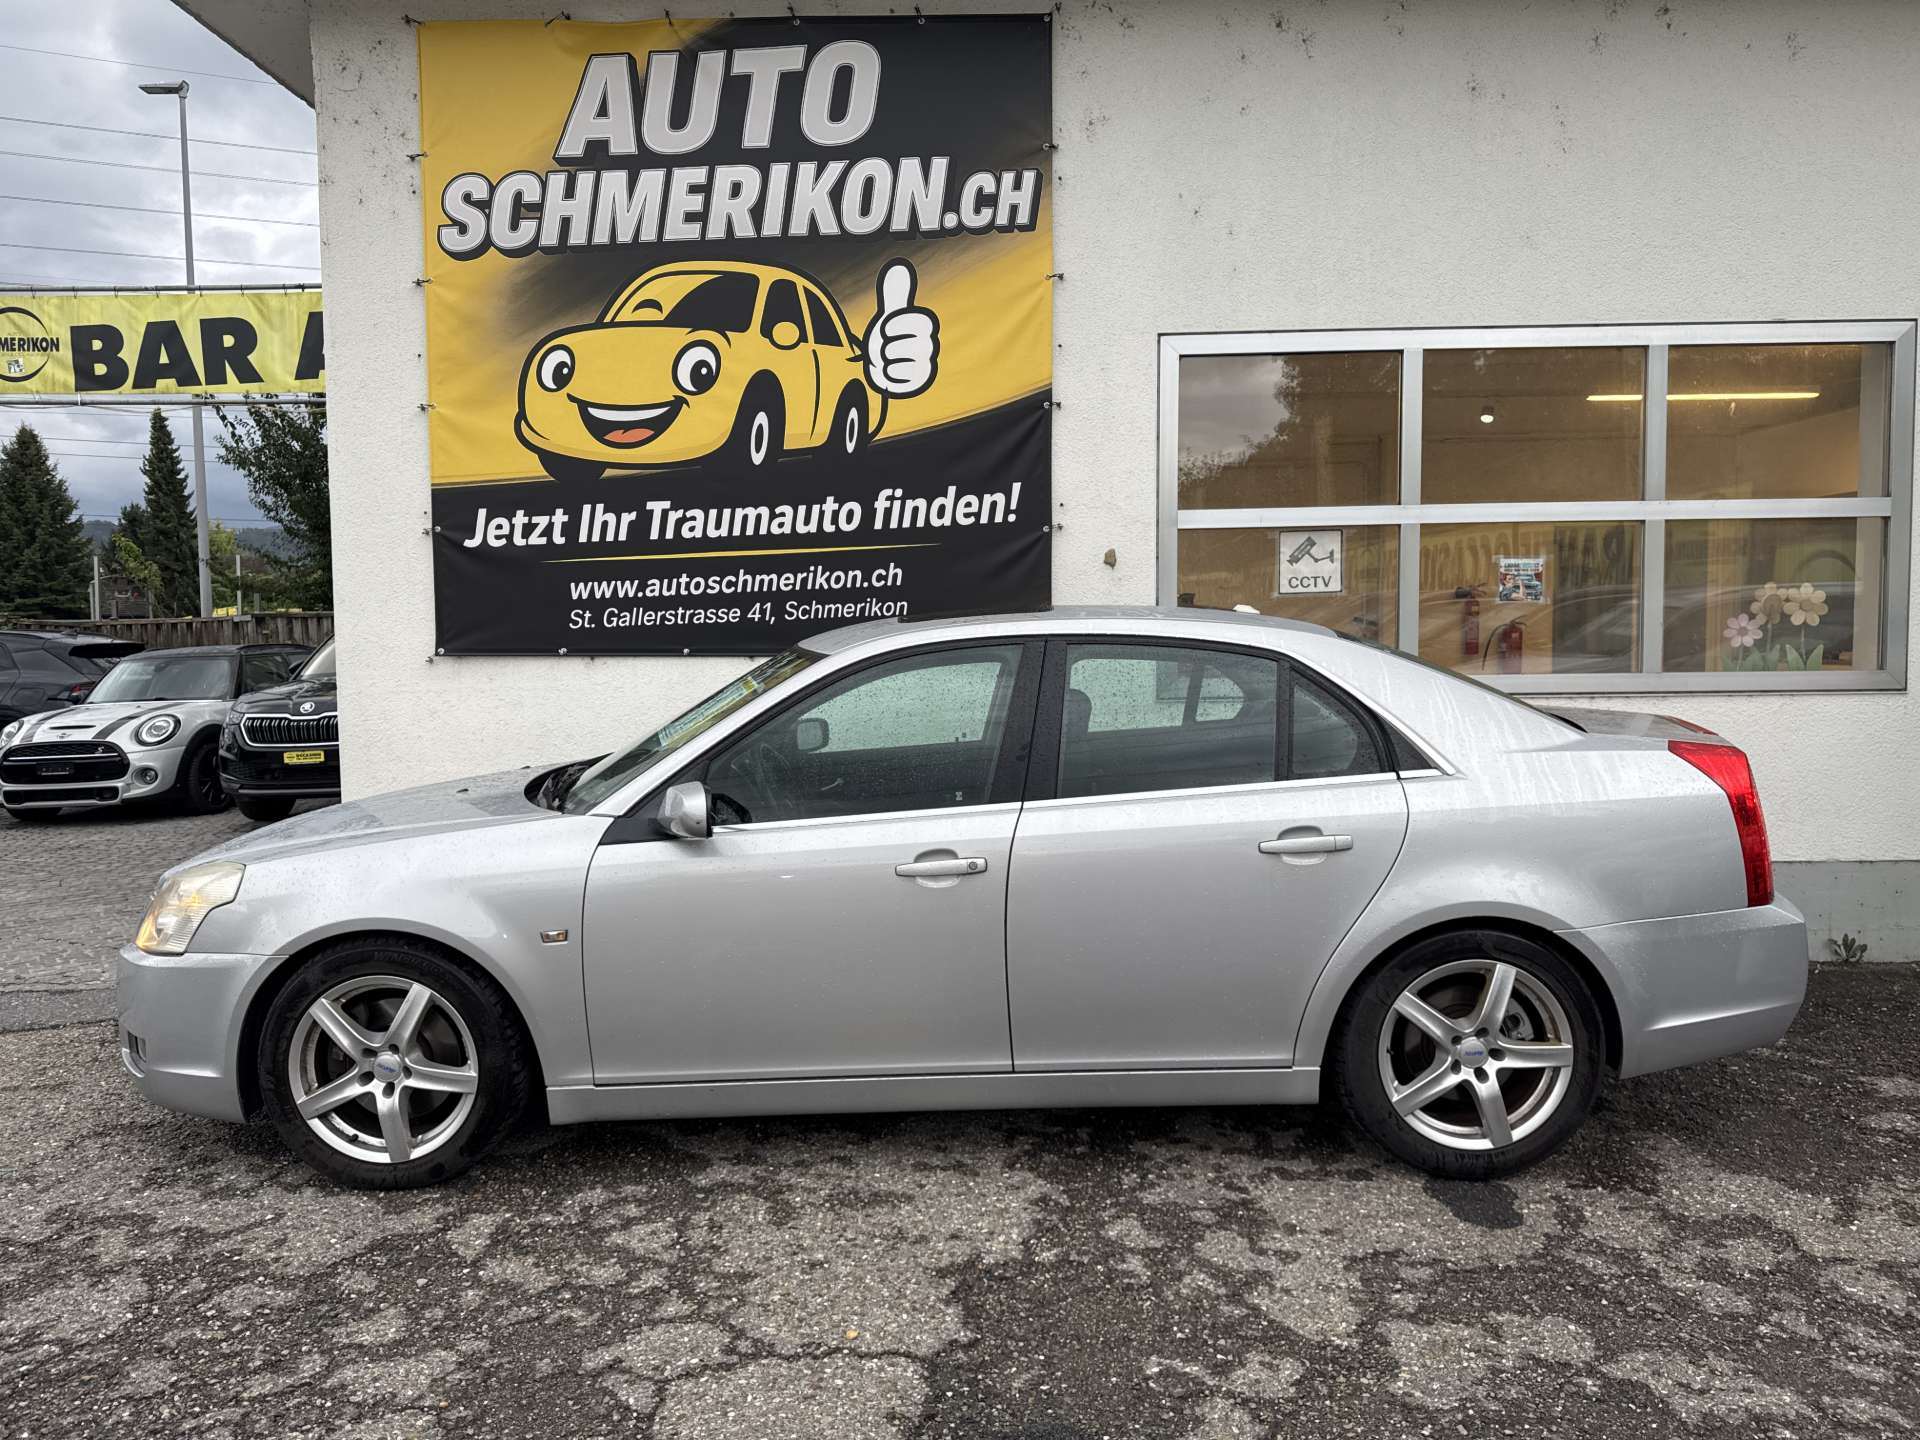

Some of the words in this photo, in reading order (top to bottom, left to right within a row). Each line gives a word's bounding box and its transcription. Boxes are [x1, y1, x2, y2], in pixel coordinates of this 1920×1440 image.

[555, 41, 882, 158] AUTO
[440, 157, 1037, 252] SCHMERIKON.CH
[70, 317, 264, 392] BAR
[463, 508, 569, 548] Jetzt
[578, 503, 642, 543] Ihr
[646, 494, 862, 540] Traumauto
[874, 481, 1023, 530] finden!
[569, 563, 903, 600] www.autoschmerikon.ch
[569, 609, 597, 629] St.
[604, 602, 742, 628] Gallerstrasse
[747, 602, 776, 624] 41,
[785, 597, 908, 622] Schmerikon
[1288, 575, 1332, 589] CCTV
